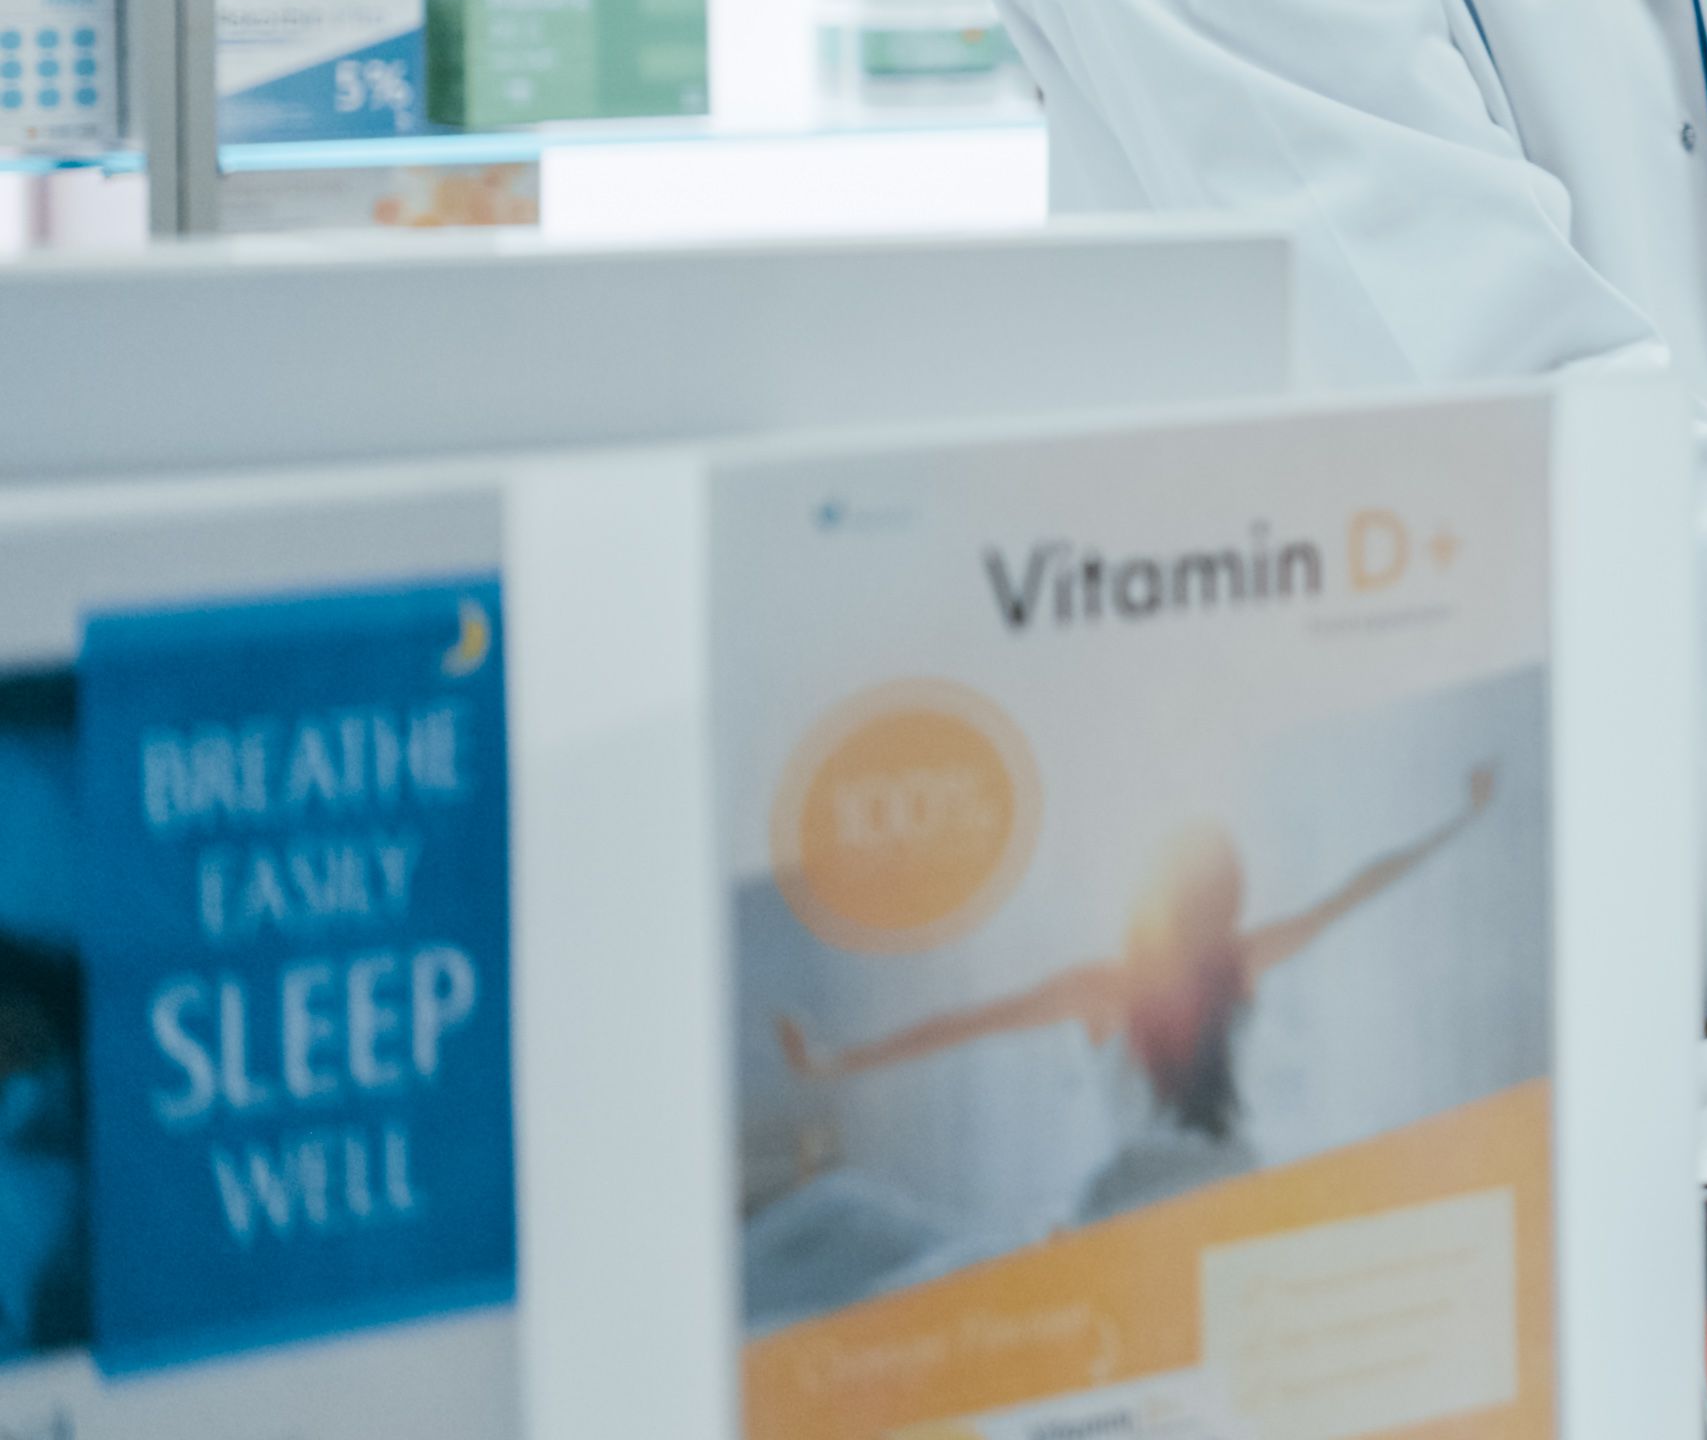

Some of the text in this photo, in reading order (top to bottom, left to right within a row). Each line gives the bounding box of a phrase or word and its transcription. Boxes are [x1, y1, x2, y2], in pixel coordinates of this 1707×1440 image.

[335, 60, 413, 112] 5%
[984, 517, 1325, 634] Vitamin
[142, 706, 466, 828] BREATHE
[198, 840, 418, 938] EASILY
[148, 942, 480, 1126] SLEEP
[211, 1126, 424, 1238] WELL
